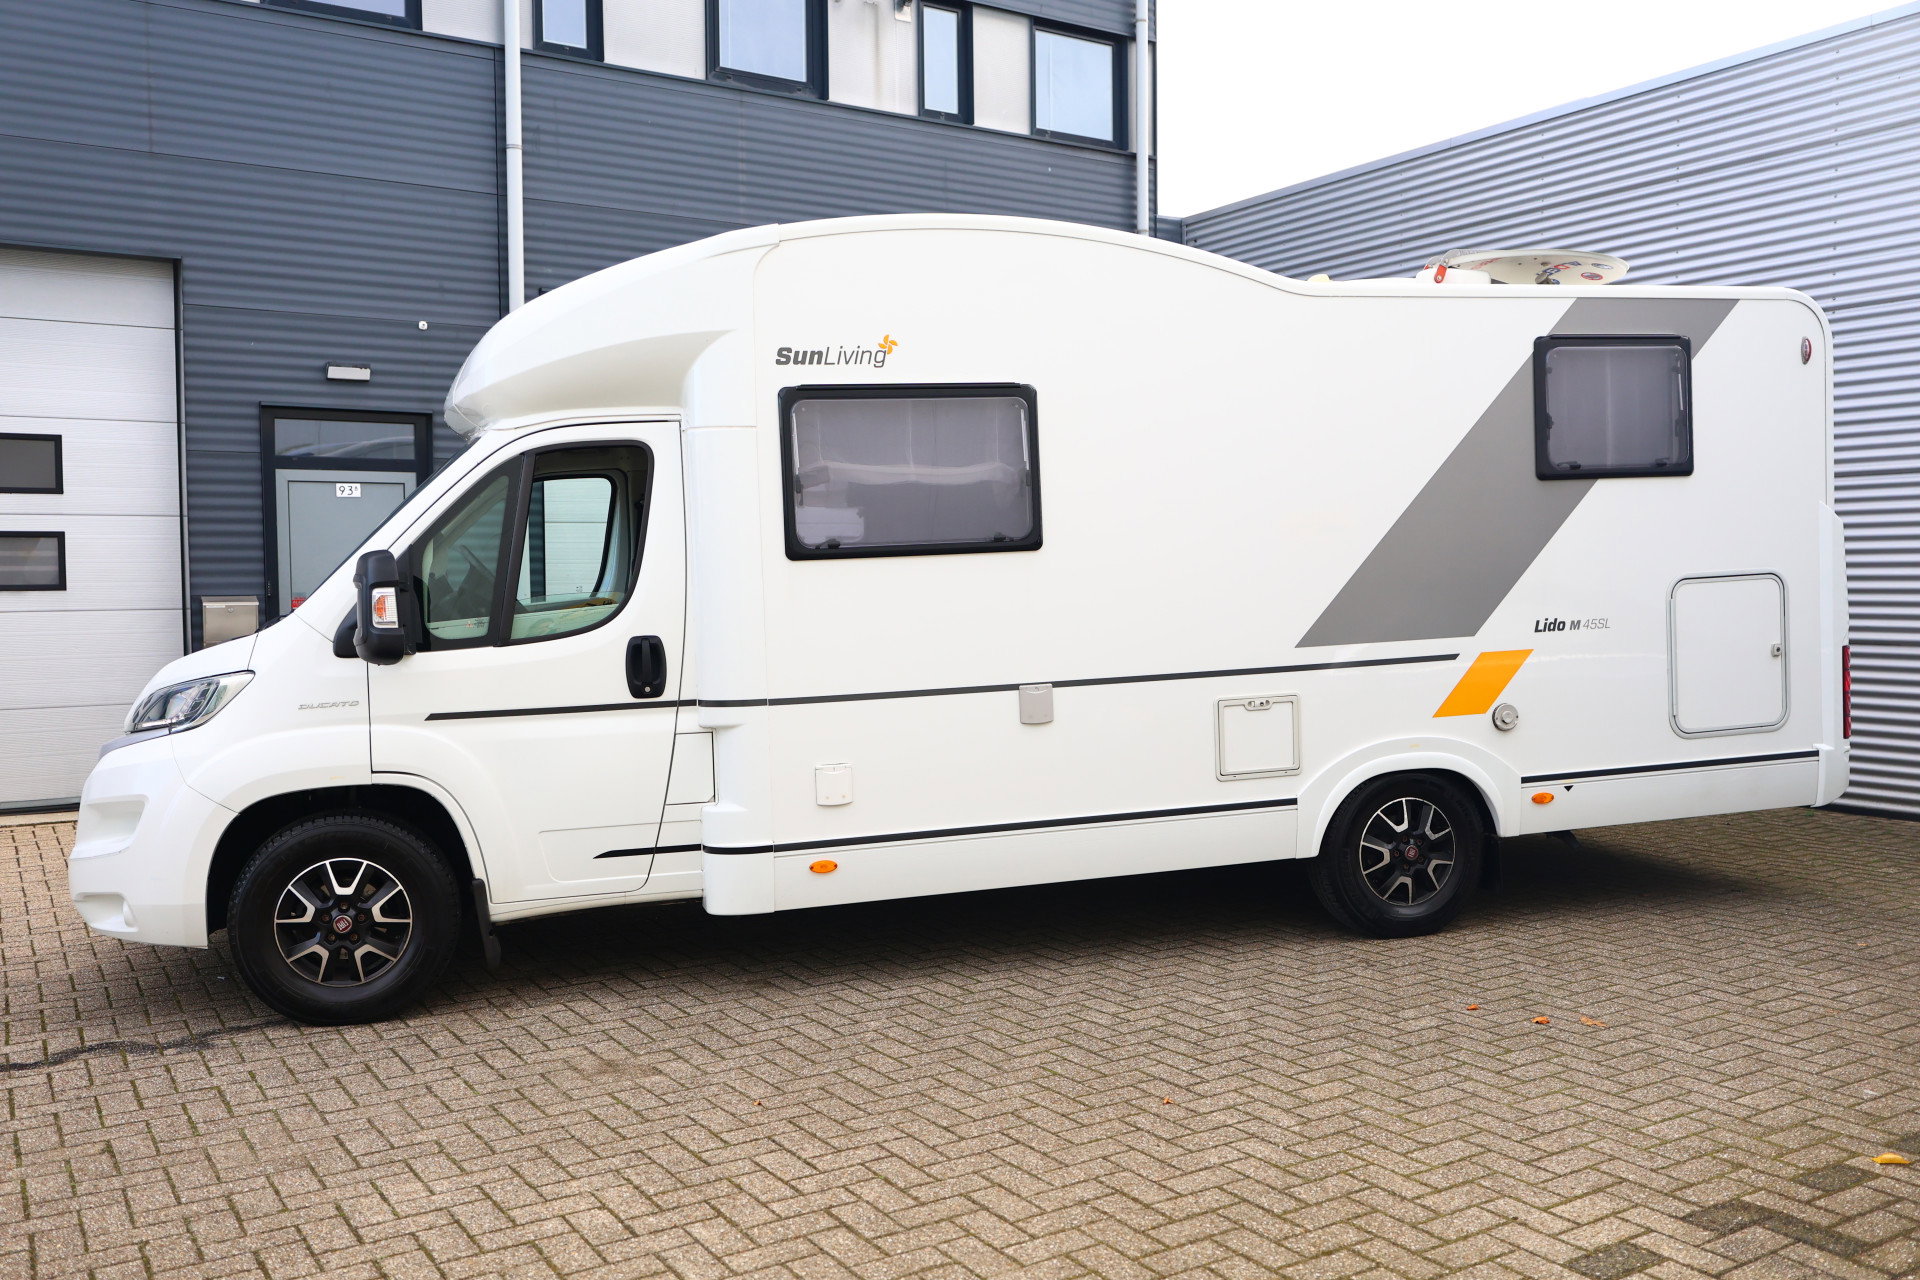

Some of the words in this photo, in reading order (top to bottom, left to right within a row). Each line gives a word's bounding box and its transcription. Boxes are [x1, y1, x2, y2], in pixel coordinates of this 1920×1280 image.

[775, 345, 887, 368] SunLiving
[1534, 617, 1566, 633] Lido
[1569, 619, 1581, 631] M
[1582, 618, 1611, 630] 45SL
[298, 700, 360, 710] DUCATO
